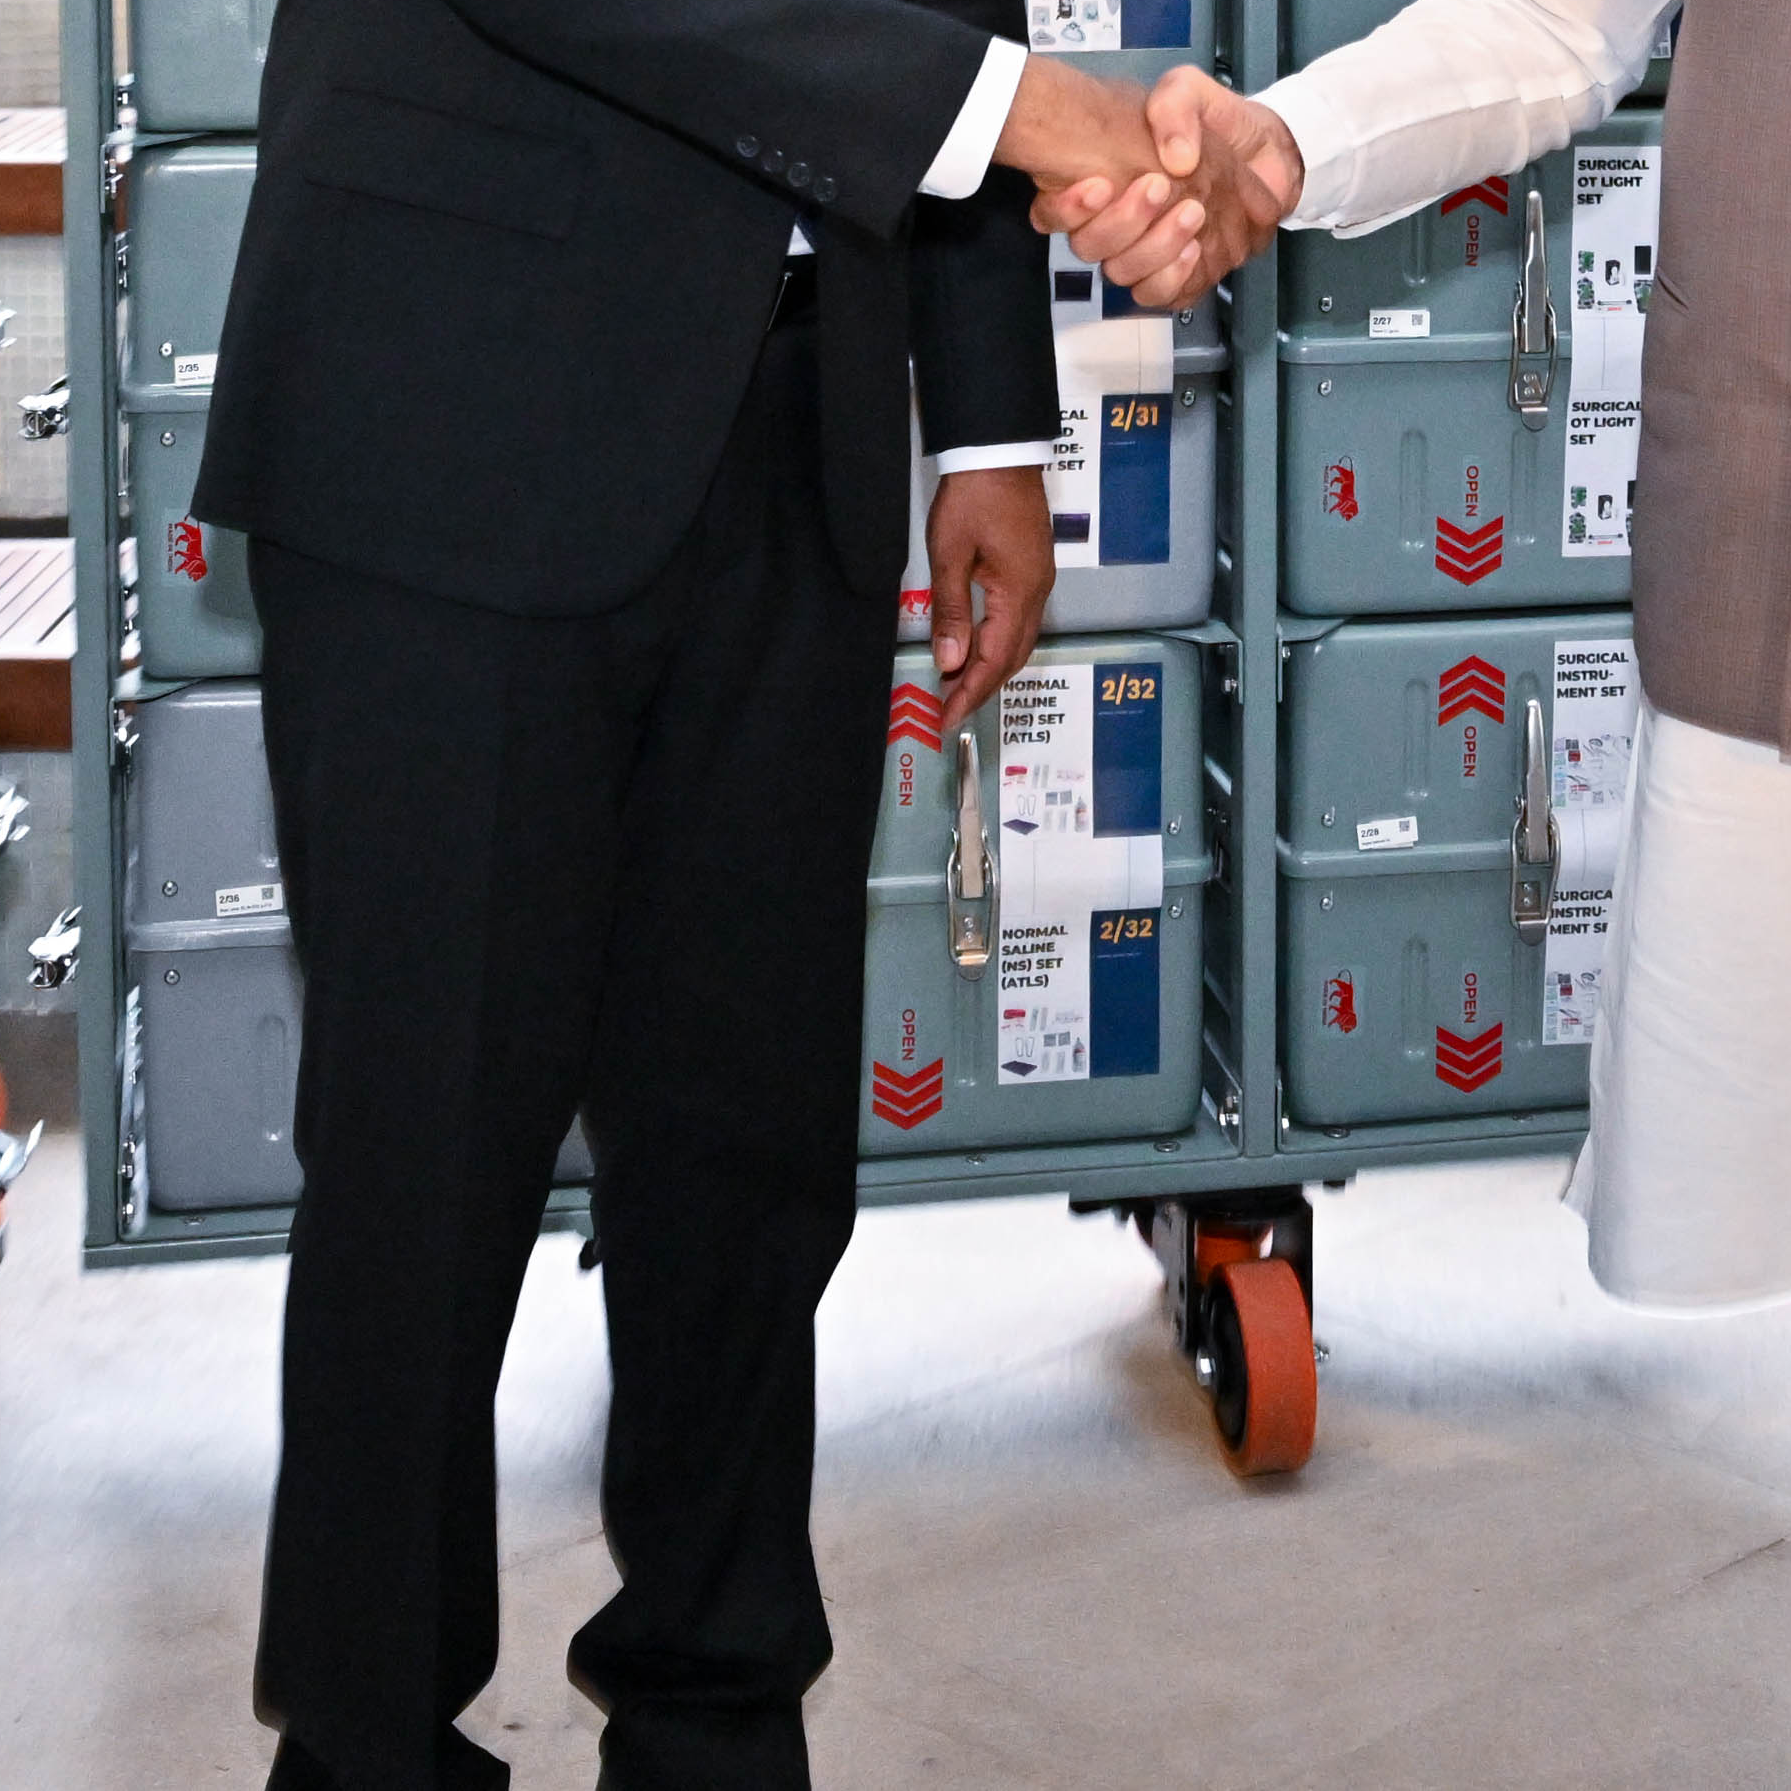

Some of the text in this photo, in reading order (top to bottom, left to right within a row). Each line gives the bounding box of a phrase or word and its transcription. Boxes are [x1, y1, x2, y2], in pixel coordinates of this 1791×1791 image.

[1578, 160, 1649, 170] SURGICAL
[1578, 177, 1642, 187] OT LIGHT
[1577, 194, 1602, 204] SET
[1465, 215, 1479, 267] OPEN
[178, 364, 199, 373] 2/35
[1111, 400, 1158, 431] 2/31
[1571, 417, 1636, 429] OT LIGHT
[1570, 434, 1596, 445] SET
[1058, 460, 1085, 471] SET
[1465, 465, 1479, 517] OPEN
[1557, 653, 1629, 664] SURGICAL
[1557, 670, 1614, 681] INSTRU-
[1004, 679, 1069, 691] NORMAL
[1102, 674, 1155, 706] 2/32
[1557, 686, 1626, 698] MENT SET
[1004, 696, 1057, 710] SALINE
[1004, 713, 1065, 728] (NS) SET
[1004, 729, 1050, 745] (ATLS)
[1463, 726, 1476, 777] OPEN
[899, 754, 912, 807] OPEN
[1553, 890, 1612, 901] SURGICA
[1552, 906, 1606, 918] INSTRU-
[1002, 924, 1068, 938] NORMAL
[1100, 918, 1153, 942] 2/32
[1550, 924, 1589, 935] MENT
[1002, 941, 1056, 954] SALINE
[1001, 957, 1064, 973] (NS) SET
[1001, 974, 1049, 990] (ATLS)
[1464, 973, 1476, 1024] OPEN
[901, 1008, 915, 1061] OPEN
